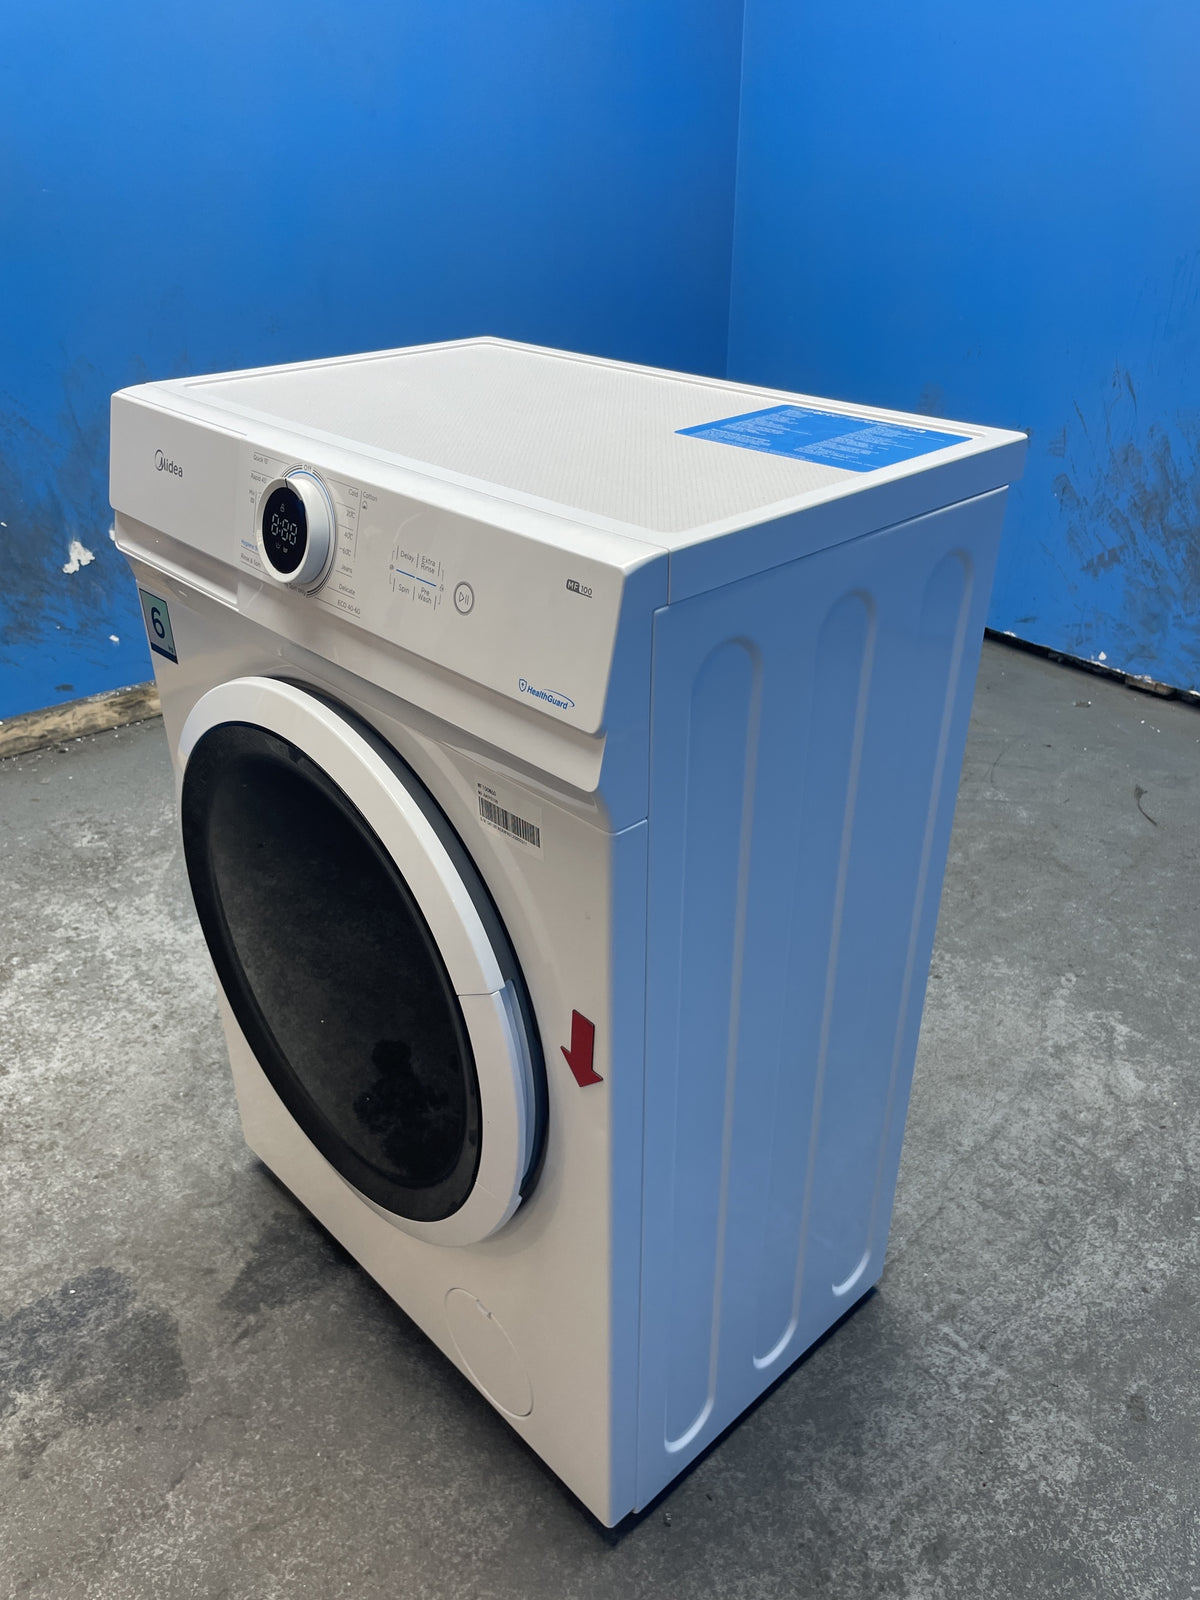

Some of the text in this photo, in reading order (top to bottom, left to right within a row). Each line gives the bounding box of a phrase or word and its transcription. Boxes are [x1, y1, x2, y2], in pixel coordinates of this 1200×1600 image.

[154, 449, 183, 478] Midea
[348, 488, 359, 498] Cold
[362, 491, 378, 502] Cotton
[400, 550, 415, 563] Delay
[421, 555, 436, 567] Extra
[420, 562, 435, 574] Rinse
[338, 583, 356, 595] Delicate
[398, 583, 410, 594] Spin
[420, 586, 430, 597] Pre
[567, 580, 593, 596] MF 100
[417, 592, 432, 605] Wash
[151, 606, 166, 639] 6
[526, 685, 569, 710] HealthGuard
